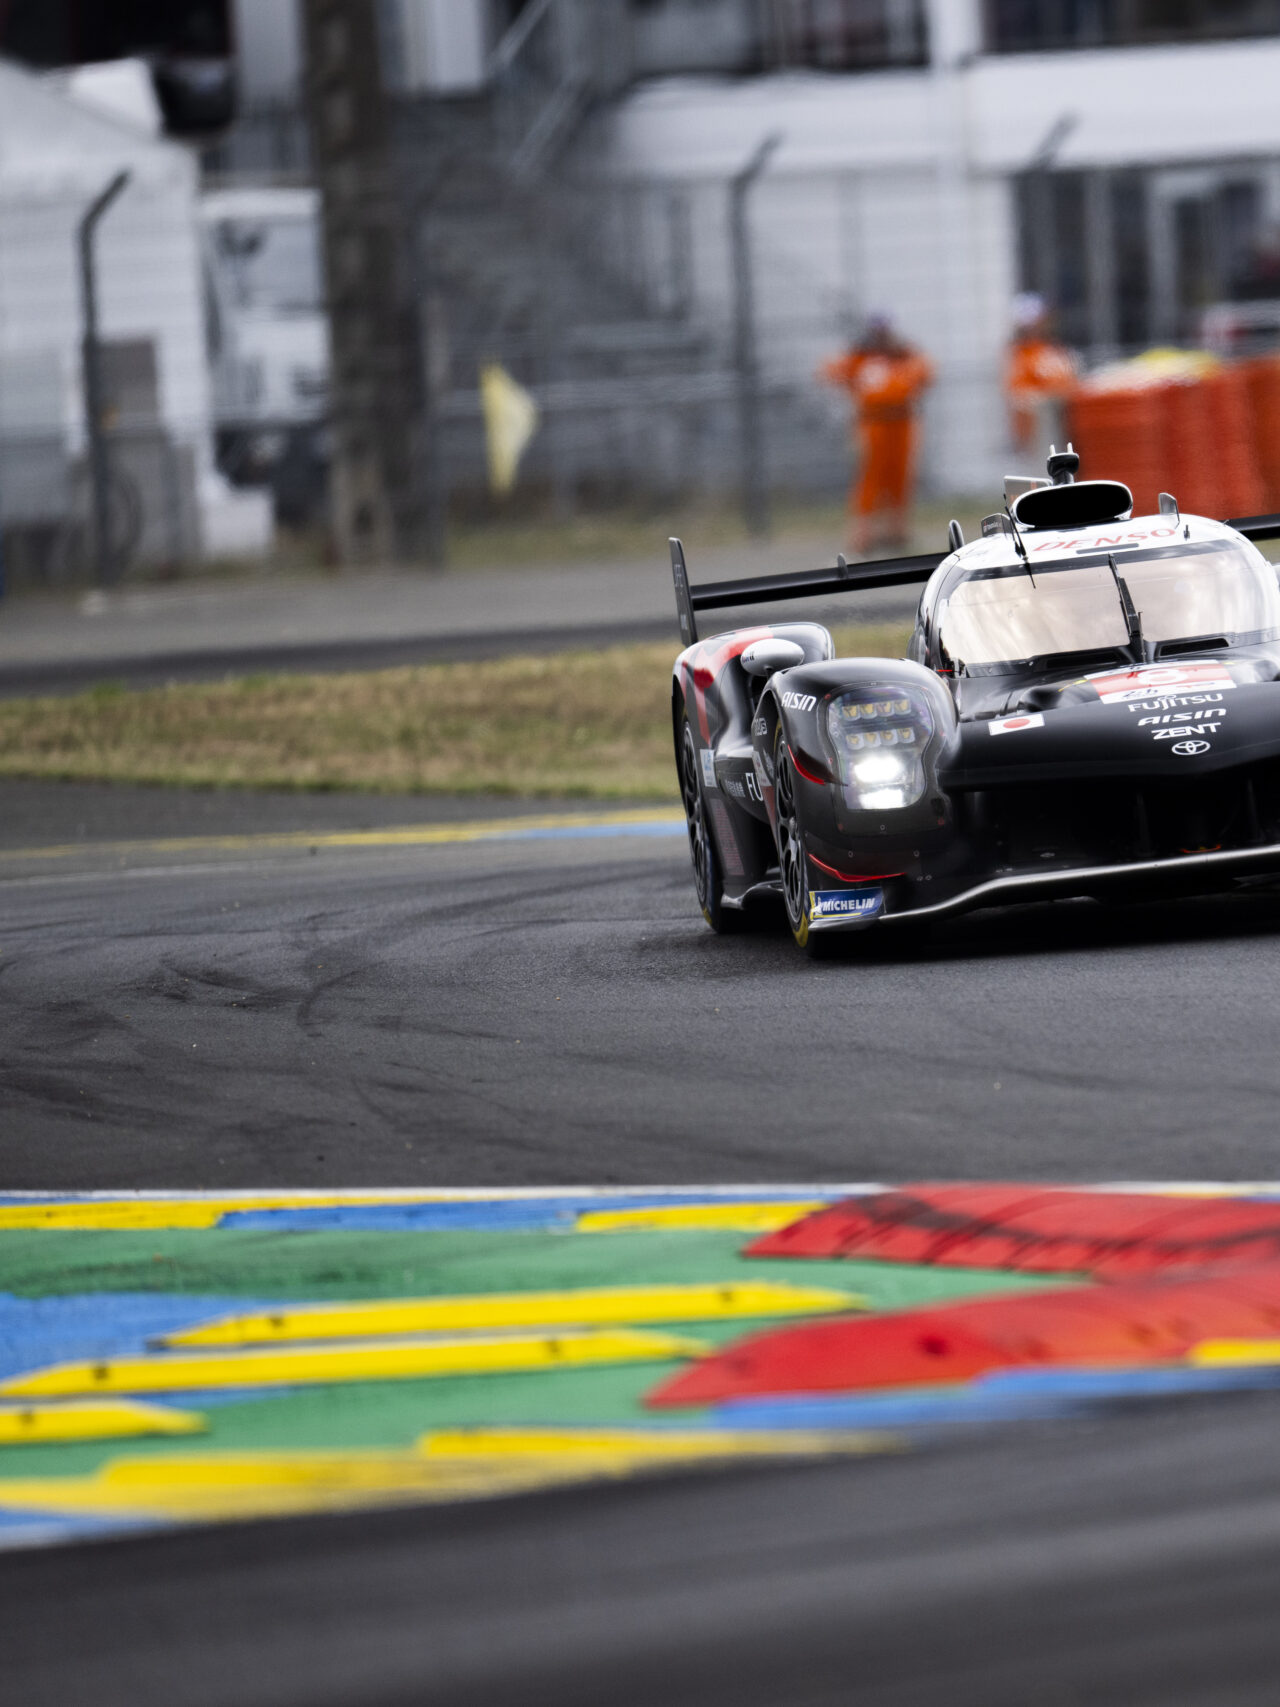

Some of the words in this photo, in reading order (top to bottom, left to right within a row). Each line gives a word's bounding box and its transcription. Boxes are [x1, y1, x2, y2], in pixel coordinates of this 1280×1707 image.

[1033, 528, 1176, 551] DENSO
[781, 691, 817, 712] AISIN
[1128, 693, 1224, 713] FUJITSU
[1137, 708, 1227, 726] AISIN
[1151, 722, 1221, 740] ZENT
[822, 897, 876, 912] MICHELIN
